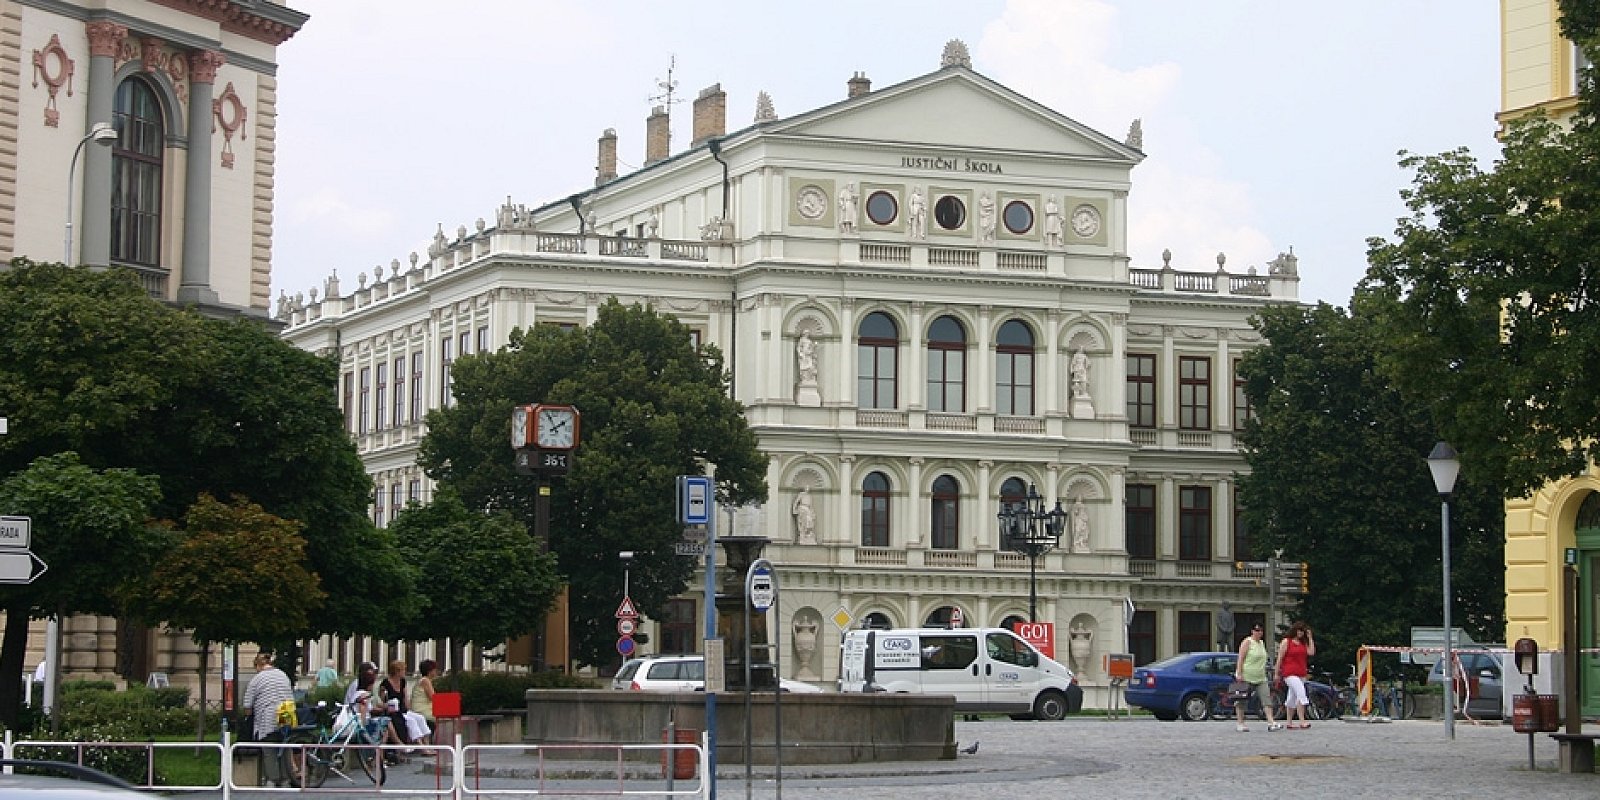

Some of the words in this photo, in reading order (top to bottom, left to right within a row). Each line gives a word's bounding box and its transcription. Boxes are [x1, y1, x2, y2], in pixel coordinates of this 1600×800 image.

[901, 156, 958, 171] JUSTIČNÍ
[964, 158, 1003, 174] ŠKOLA
[1020, 624, 1048, 643] GO!
